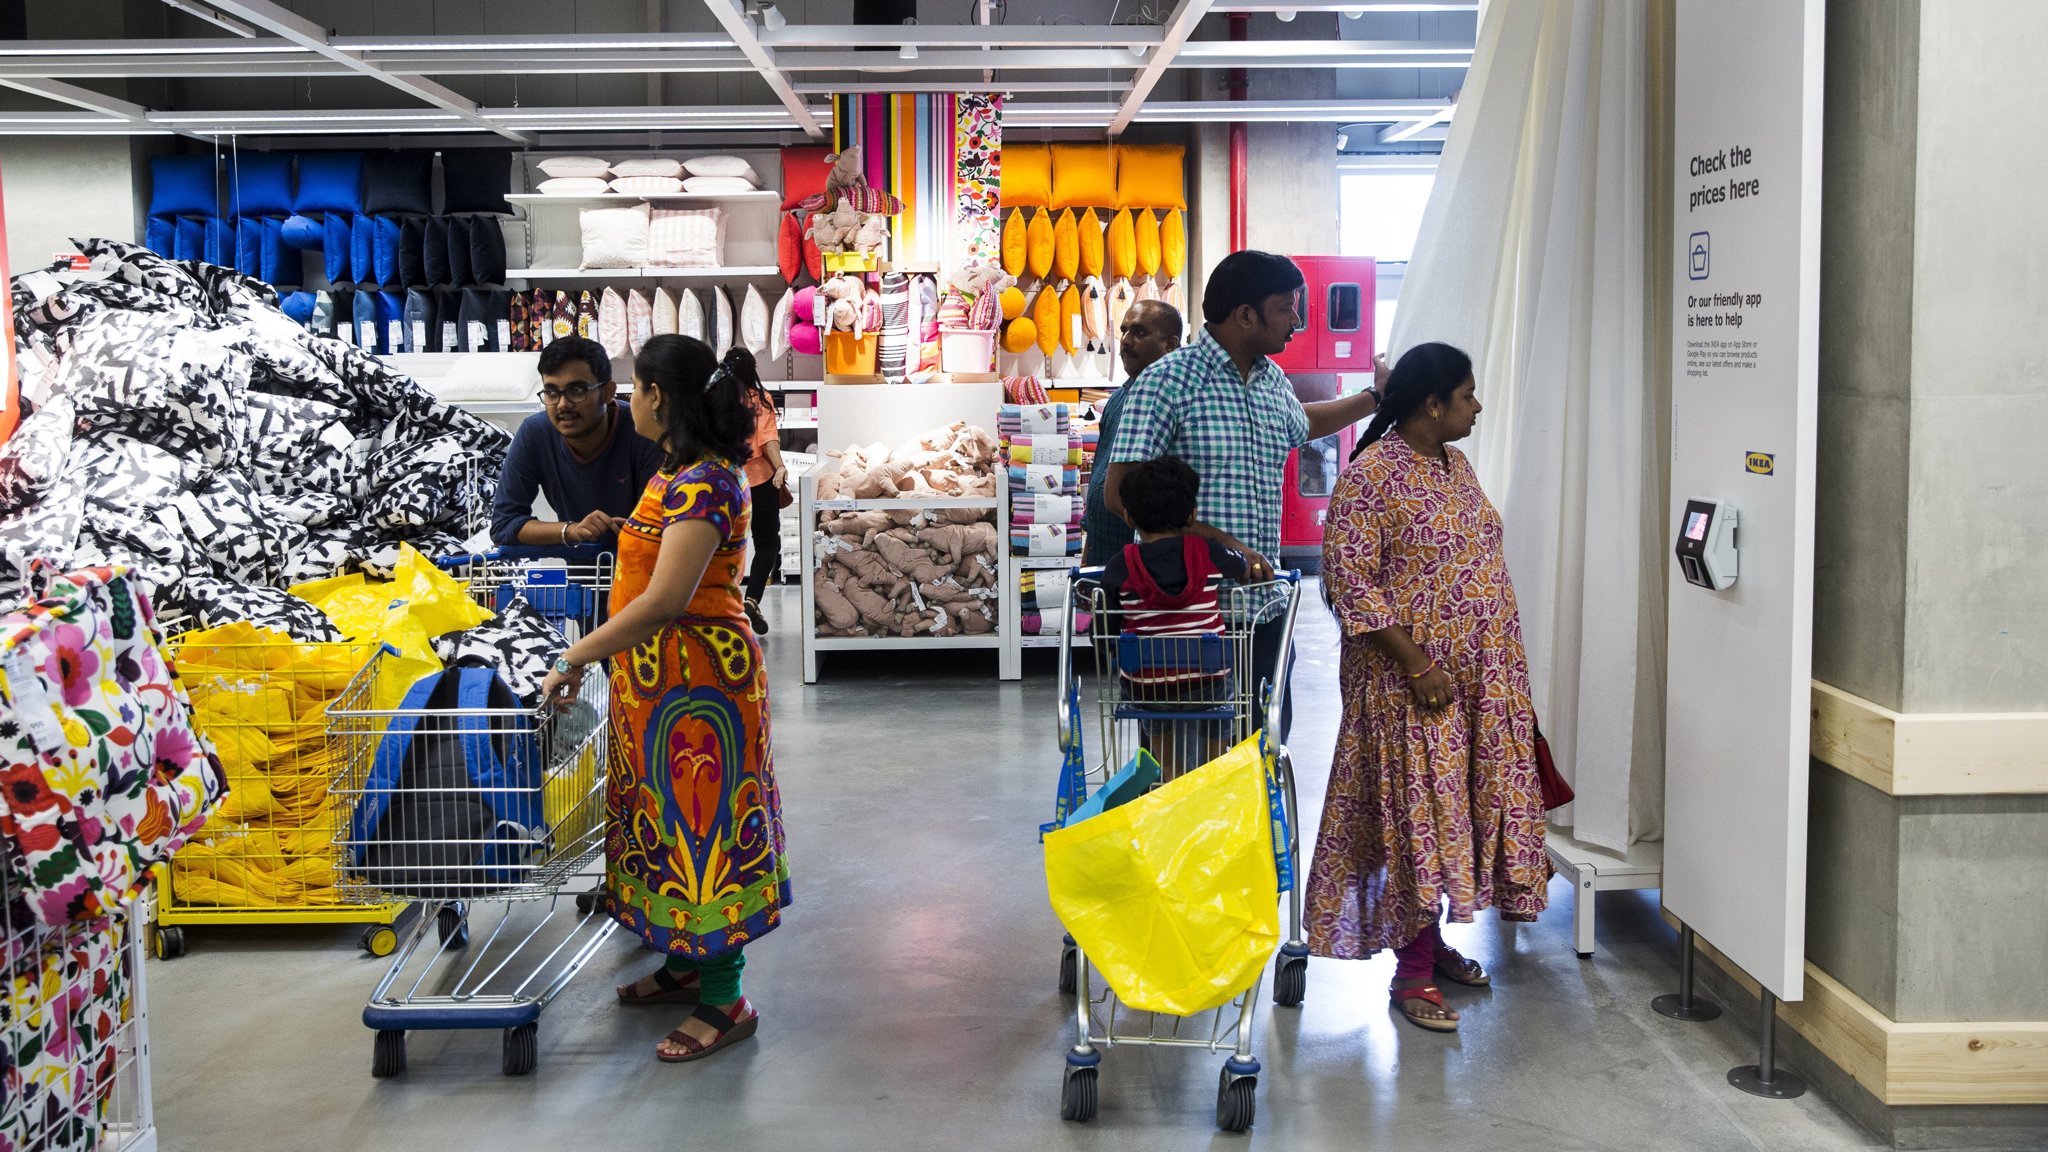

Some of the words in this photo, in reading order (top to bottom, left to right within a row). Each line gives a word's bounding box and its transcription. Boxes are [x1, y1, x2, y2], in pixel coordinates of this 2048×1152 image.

[1690, 150, 1726, 177] Check
[1730, 145, 1751, 168] the
[1690, 185, 1726, 212] prices
[1730, 179, 1759, 200] here
[1688, 295, 1697, 308] Or
[1699, 297, 1711, 308] our
[1713, 292, 1743, 308] friendly
[1746, 294, 1762, 308] app
[1688, 314, 1694, 327] is
[1696, 314, 1713, 327] here
[1715, 314, 1723, 326] to
[1725, 312, 1743, 328] help
[1687, 370, 1701, 378] shopping
[1749, 458, 1770, 469] IKEA
